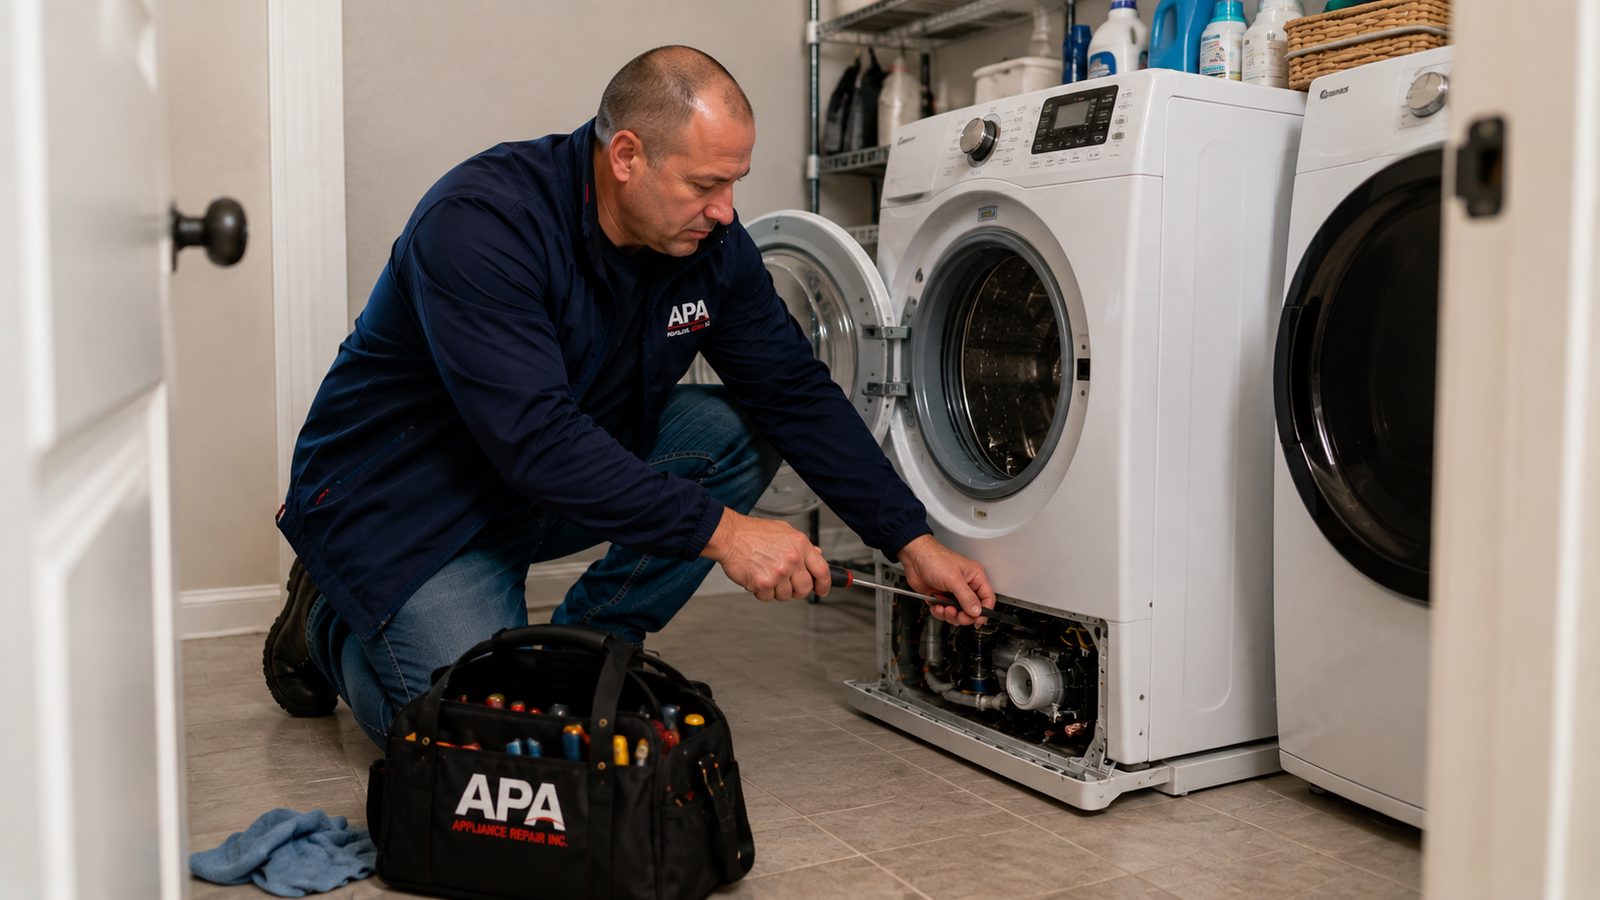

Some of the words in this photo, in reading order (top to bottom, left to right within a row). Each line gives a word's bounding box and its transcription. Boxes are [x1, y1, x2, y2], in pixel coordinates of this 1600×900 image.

[668, 299, 710, 327] APA
[455, 773, 566, 831] APA
[452, 820, 507, 839] APPLIANCE
[509, 828, 545, 845] REPAIR
[548, 833, 568, 847] INC.
